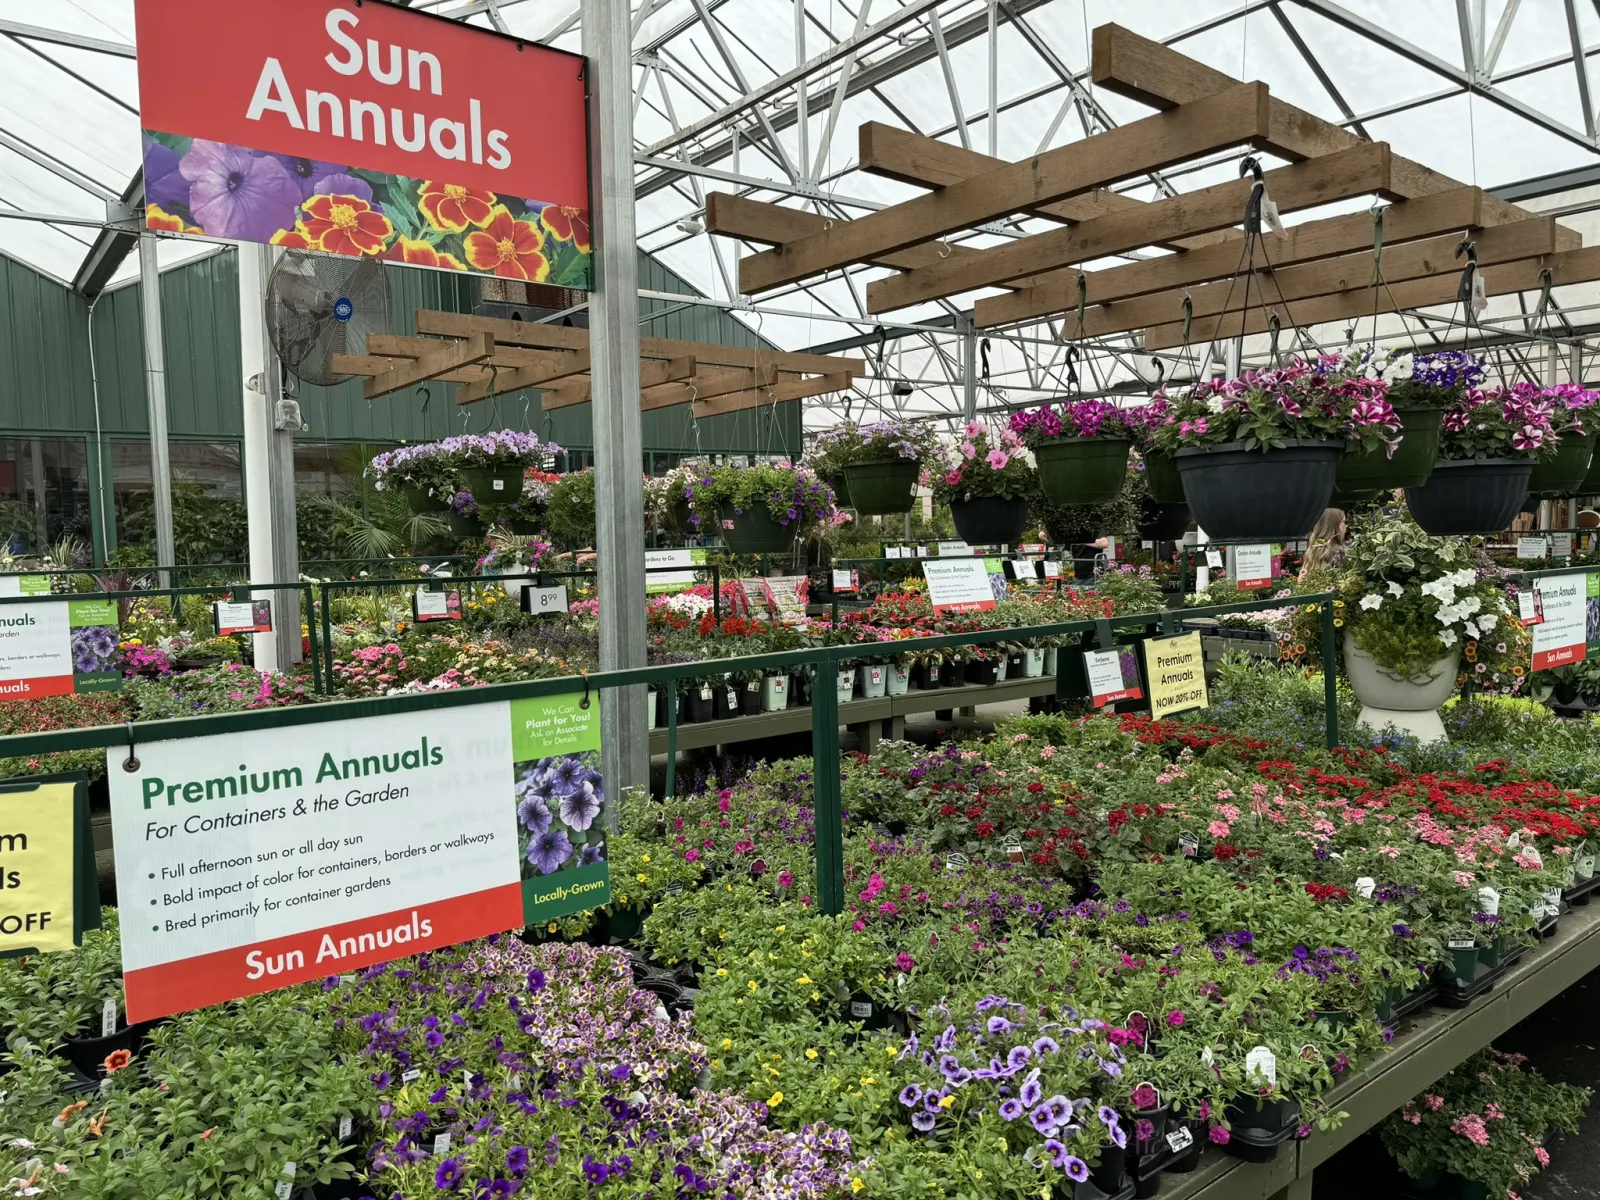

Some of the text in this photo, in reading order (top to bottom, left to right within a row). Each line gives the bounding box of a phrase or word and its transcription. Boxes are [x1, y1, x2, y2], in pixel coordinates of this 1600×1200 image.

[325, 9, 442, 95] Sun
[245, 57, 512, 170] Annuals
[1559, 584, 1576, 597] Annuals
[1158, 653, 1192, 668] Premium
[1547, 647, 1572, 662] Sun Annuals
[1161, 669, 1193, 685] Annuals
[1156, 690, 1202, 708] NOW 20% OFF
[525, 713, 590, 729] Plant for You!
[542, 705, 574, 716] We Can
[530, 730, 544, 738] Ask
[556, 724, 588, 735] Associate
[543, 736, 577, 746] for Details
[142, 736, 443, 810] Premium Annuals
[146, 783, 409, 841] For Containers & the Garden
[161, 835, 363, 880] Full afternoon sun or all day sun
[164, 831, 494, 906] Bold impact of color for containers, borders or walkways
[534, 879, 604, 904] Locally-Grown
[166, 874, 391, 932] Bred primarily for container gardens
[0, 912, 52, 934] OFF
[246, 911, 432, 980] Sun Annuals
